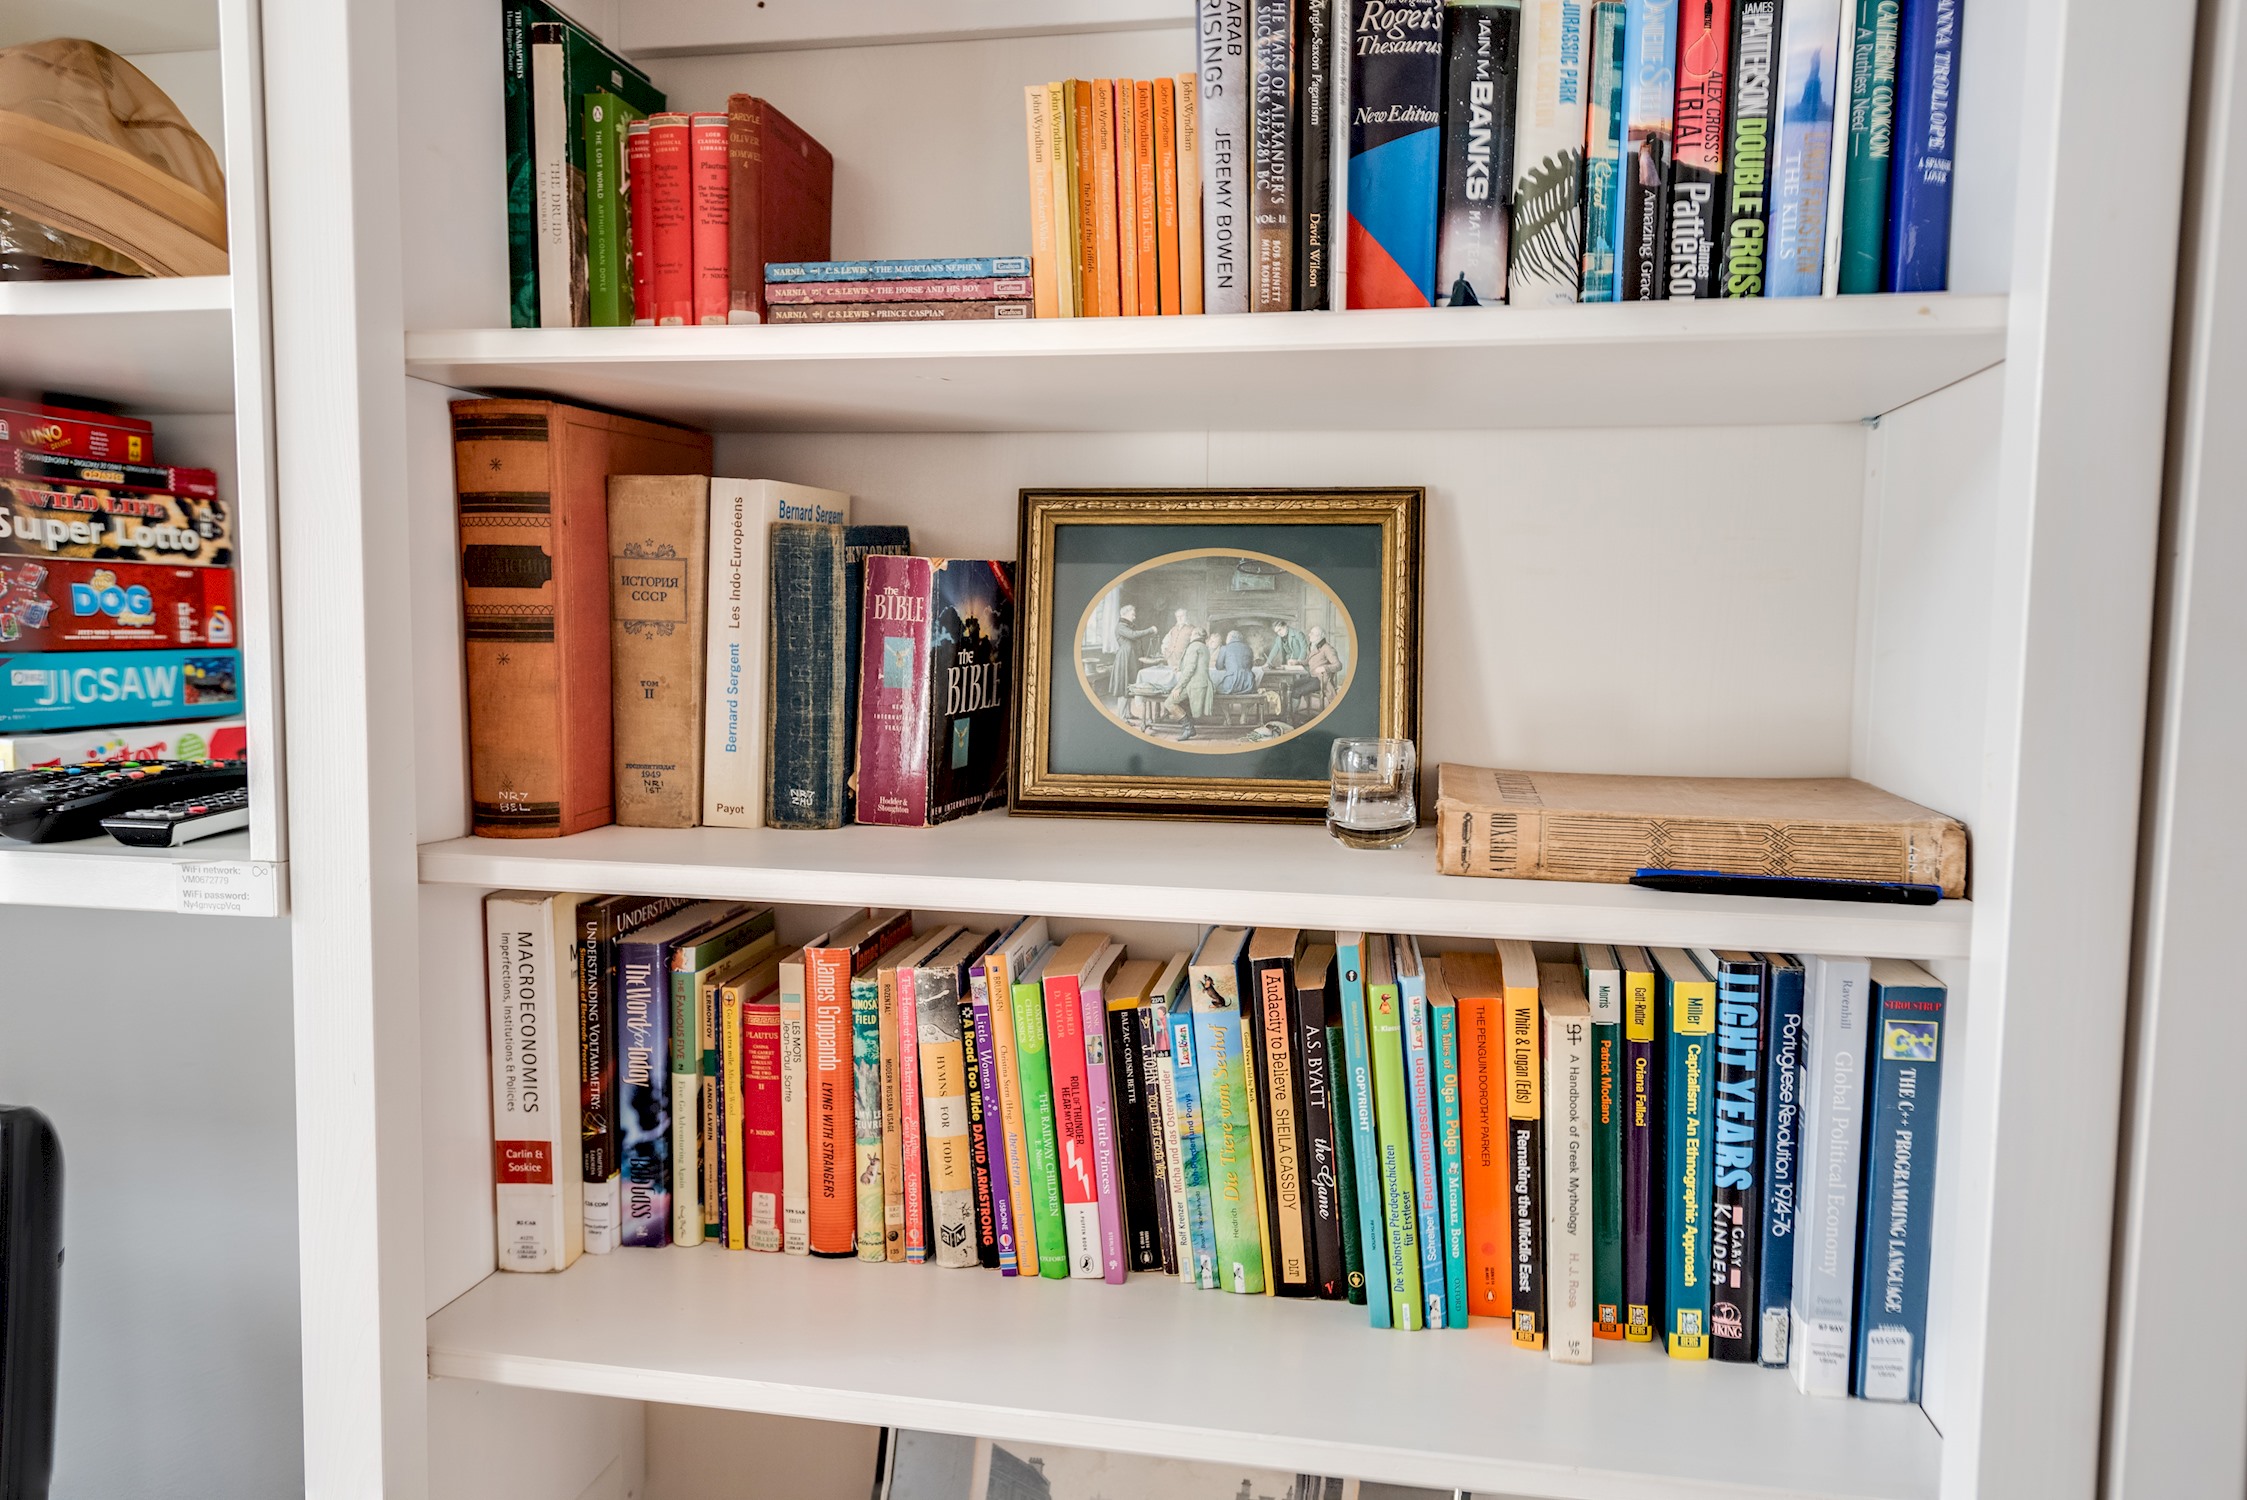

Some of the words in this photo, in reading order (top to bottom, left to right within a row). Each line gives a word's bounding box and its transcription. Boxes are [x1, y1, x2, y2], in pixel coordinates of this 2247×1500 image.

[515, 10, 523, 28] THE
[1742, 2, 1774, 15] JAMES
[1227, 1, 1242, 56] ARAB
[1356, 34, 1443, 56] Thesaurus
[1560, 0, 1581, 66] JURASSIC
[1873, 1, 1900, 85] CATHERINE
[515, 29, 524, 80] ANABAPTISTS
[1738, 14, 1774, 118] PATTERSON
[1032, 93, 1041, 109] John
[1050, 90, 1060, 108] John
[1182, 80, 1193, 101] John
[1559, 69, 1578, 104] PARK
[729, 112, 760, 124] CARLYLE
[1183, 103, 1196, 151] Wyndham
[1353, 106, 1388, 125] New
[1387, 104, 1440, 122] Edition
[1676, 82, 1705, 153] TRIAL
[1869, 85, 1894, 159] COOKSON
[730, 134, 760, 146] OLIVER
[1033, 111, 1045, 163] Wyndham
[1052, 111, 1062, 161] Wyndham
[550, 160, 561, 189] THE
[1215, 127, 1232, 208] JEREMY
[1783, 153, 1801, 196] THE
[1924, 170, 1948, 184] LOVER
[551, 192, 563, 245] DRUIDS
[1309, 212, 1321, 246] David
[1639, 190, 1656, 257] Amazing
[1780, 203, 1798, 260] KILLS
[1216, 215, 1233, 289] BOWEN
[1468, 210, 1482, 270] MATTER
[1697, 237, 1714, 279] James
[997, 262, 1022, 270] Grafton
[1309, 247, 1321, 288] Wilson
[1640, 262, 1654, 301] Grace
[997, 284, 1022, 292] Grafton
[775, 311, 808, 319] NARNIA
[877, 310, 907, 318] PRINCE
[908, 309, 945, 318] CASPIAN
[999, 308, 1022, 316] Grafton
[20, 424, 63, 446] UNO
[81, 469, 125, 484] BINGO
[16, 488, 100, 511] WILD
[104, 497, 165, 518] LIFE
[779, 500, 814, 521] Bernard
[815, 505, 844, 525] Sergent
[0, 507, 106, 551] Super
[115, 518, 201, 552] Lotto
[729, 496, 745, 601] Indo-Européens
[71, 582, 153, 617] DOG
[621, 575, 679, 588] ИСТОРИЯ
[631, 591, 668, 602] СССР
[729, 605, 741, 629] Les
[873, 593, 925, 623] BIBLE
[35, 664, 178, 706] JIGSAW
[727, 643, 742, 695] Sergent
[945, 661, 1002, 716] BIBLE
[725, 700, 739, 753] Bernard
[641, 770, 662, 779] 1949
[716, 803, 745, 815] Payot
[877, 804, 909, 814] Stoughton
[181, 865, 201, 873] WiFi
[203, 866, 241, 875] network:
[183, 890, 202, 899] WiFi
[204, 891, 250, 901] password:
[500, 932, 514, 1002] Imperfections,
[586, 921, 599, 1022] UNDERSTANDING
[816, 958, 841, 1002] James
[1064, 992, 1075, 1036] MILDRED
[1266, 975, 1287, 1033] Audacity
[1476, 1004, 1486, 1026] THE
[1599, 985, 1611, 1009] Morris
[1688, 997, 1704, 1025] Miller
[1840, 979, 1853, 1030] Ravenhill
[1884, 1000, 1942, 1012] STROUSTRUP
[501, 1005, 514, 1063] Institutions
[518, 931, 539, 1113] MACROECONOMICS
[746, 1031, 778, 1040] PLAUTUS
[856, 1014, 877, 1025] FIELD
[975, 1013, 988, 1043] Little
[1121, 1011, 1132, 1043] BALZAC
[783, 1021, 792, 1071] Jean-Paul
[793, 1036, 801, 1063] MOTS
[815, 1005, 841, 1071] Grippando
[1270, 1036, 1287, 1050] to
[1476, 1027, 1488, 1074] PENGUIN
[1888, 1027, 1933, 1052] C++
[505, 1064, 515, 1073] &
[589, 1025, 600, 1110] VOLTAMMETRY:
[979, 1049, 992, 1090] Women
[1124, 1047, 1134, 1075] COUSIN
[1569, 1054, 1580, 1064] A
[1601, 1039, 1612, 1075] Patrick
[1635, 1057, 1648, 1093] Oriana
[1776, 1013, 1801, 1104] Portuguese
[506, 1076, 517, 1112] Policies
[784, 1074, 792, 1103] Sartre
[937, 1056, 947, 1097] HYMNS
[1126, 1075, 1137, 1105] BETTE
[1272, 1052, 1288, 1101] Believe
[1569, 1066, 1580, 1122] Handbook
[1832, 1051, 1853, 1110] Global
[940, 1106, 950, 1128] FOR
[1038, 1093, 1049, 1114] THE
[1355, 1066, 1370, 1132] COPYRIGHT
[1478, 1074, 1490, 1126] DOROTHY
[1601, 1076, 1614, 1125] Modiano
[1635, 1094, 1647, 1127] Fallaci
[1040, 1115, 1055, 1162] RAILWAY
[1275, 1109, 1291, 1154] SHEILA
[1413, 1057, 1434, 1210] Feuerwehrgeschichten
[1479, 1127, 1491, 1168] PARKER
[1569, 1125, 1580, 1140] of
[1775, 1104, 1796, 1180] Revolution
[506, 1149, 533, 1159] Carlin
[535, 1150, 544, 1159] &
[508, 1162, 542, 1173] Soskice
[942, 1140, 953, 1177] TODAY
[1314, 1137, 1332, 1164] the
[1515, 1129, 1532, 1193] Remaking
[1568, 1141, 1580, 1174] Greek
[1827, 1115, 1850, 1190] Political
[630, 1157, 651, 1185] BOB
[1279, 1156, 1297, 1211] CASSIDY
[631, 1186, 656, 1219] GASS
[1045, 1162, 1059, 1217] CHILDREN
[1311, 1164, 1335, 1220] Game
[1518, 1194, 1532, 1218] the
[1567, 1176, 1580, 1236] Mythology
[999, 1199, 1009, 1231] USBORNE
[1231, 1207, 1240, 1239] Heidrich
[1769, 1182, 1793, 1238] 1974-76
[1427, 1215, 1437, 1262] Schreiber
[1518, 1219, 1533, 1262] Middle
[1818, 1191, 1845, 1278] Economy
[1568, 1267, 1580, 1277] J.
[1569, 1252, 1580, 1265] H.
[1454, 1277, 1462, 1312] OXFORD
[1519, 1264, 1533, 1293] East
[1568, 1278, 1579, 1308] Rose
